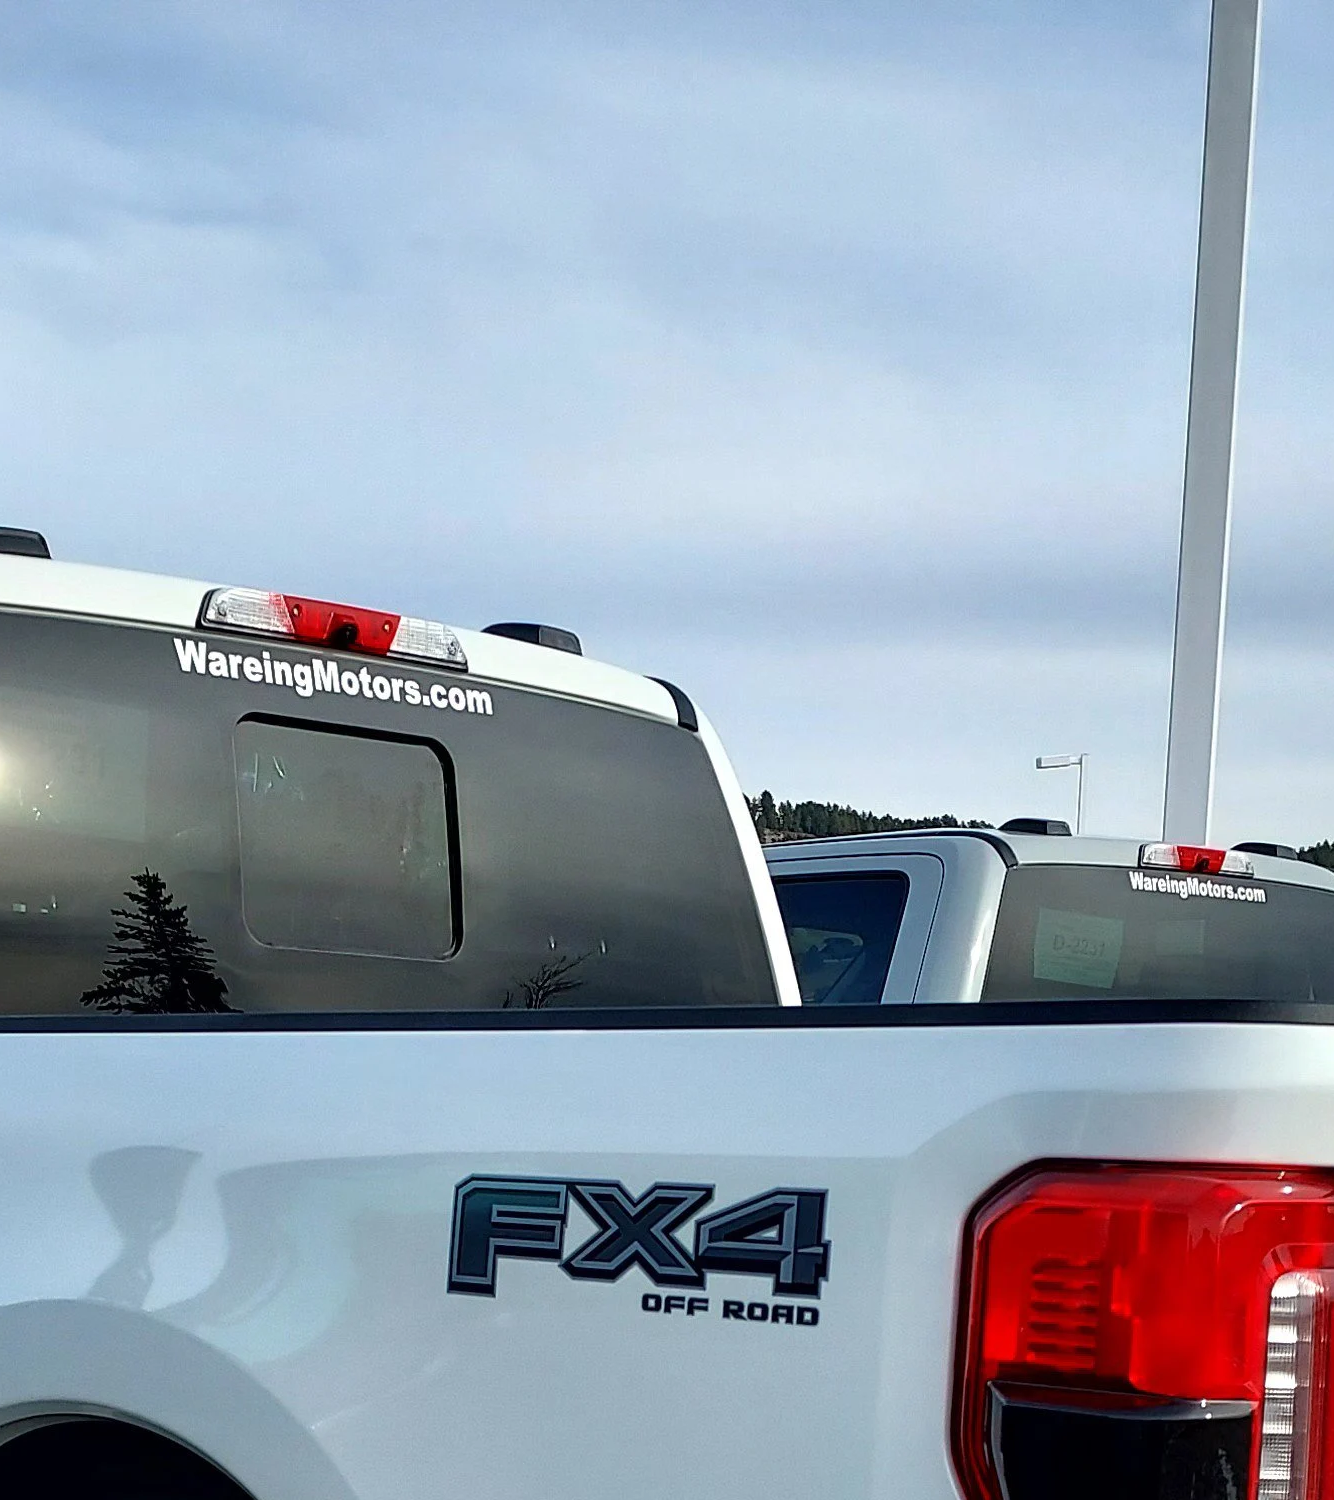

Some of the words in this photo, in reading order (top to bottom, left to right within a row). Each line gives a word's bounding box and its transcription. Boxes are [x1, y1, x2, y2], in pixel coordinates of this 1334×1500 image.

[173, 638, 494, 715] WareingMotors.com
[1129, 871, 1266, 902] WareingMotors.com
[447, 1173, 831, 1299] FX4
[641, 1293, 709, 1317] OFF
[723, 1299, 819, 1326] ROAD
